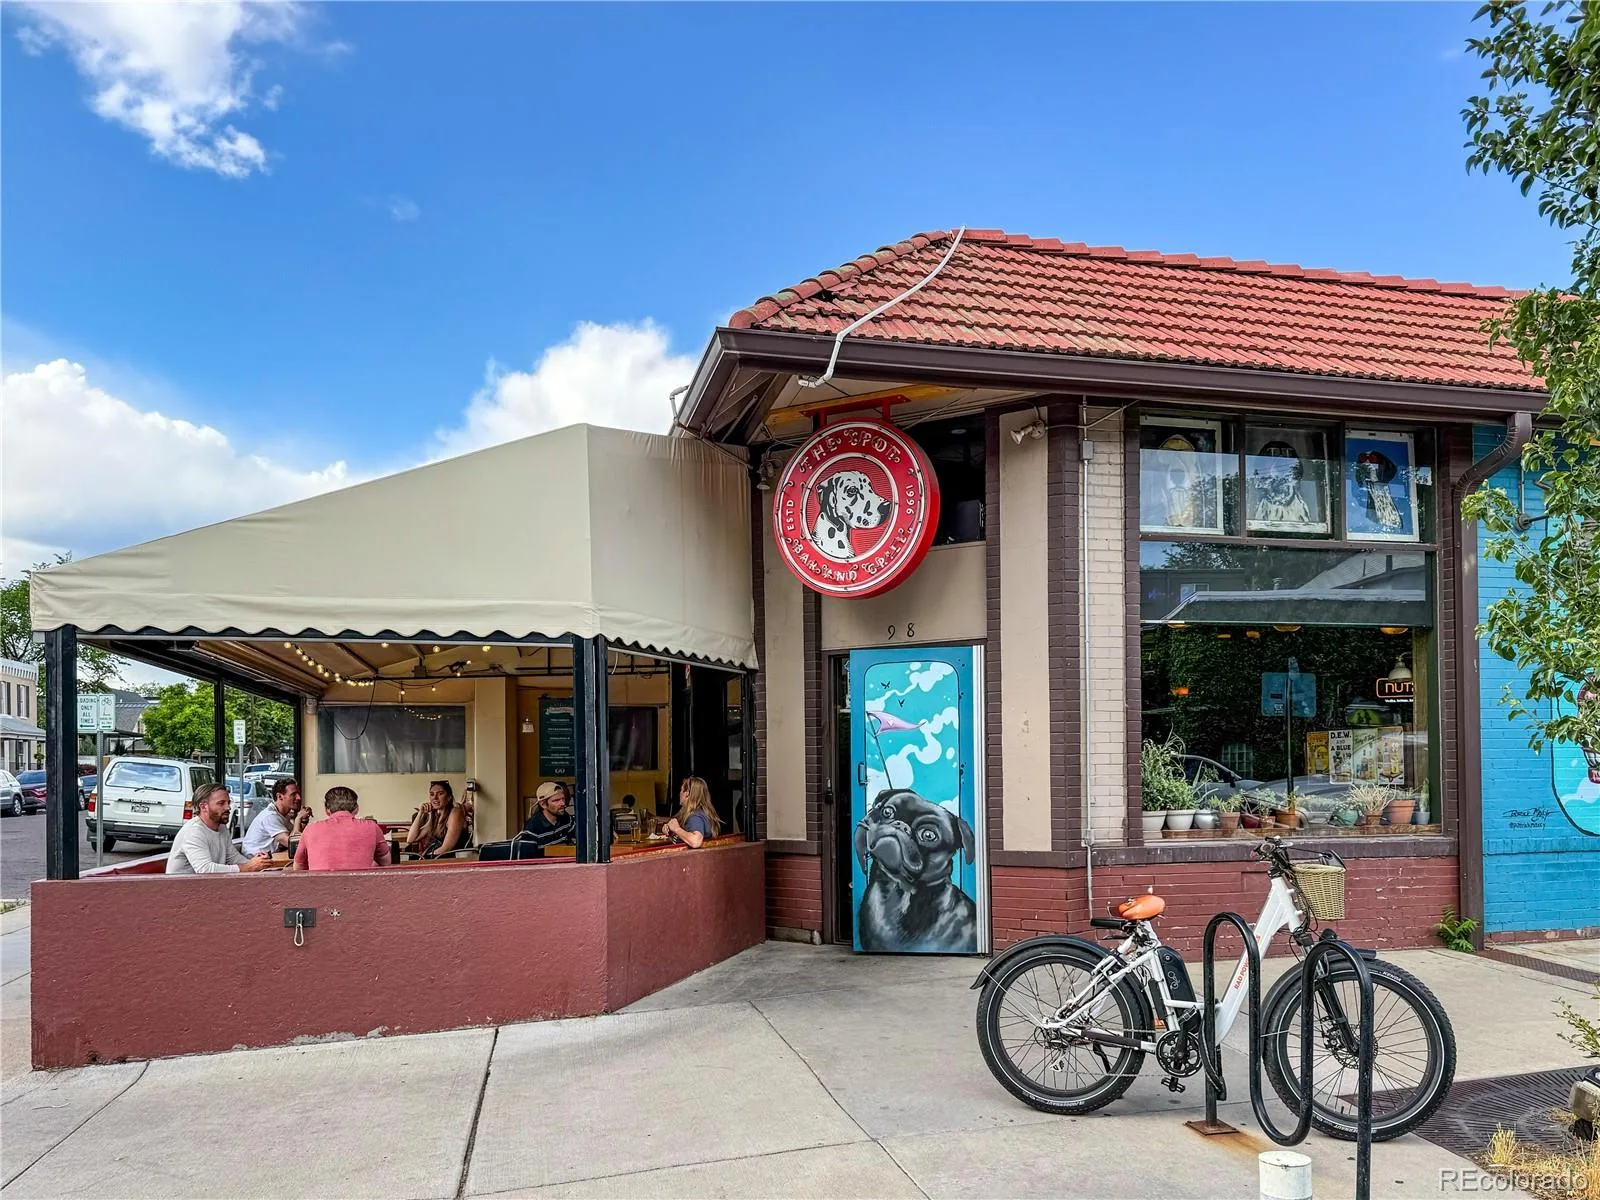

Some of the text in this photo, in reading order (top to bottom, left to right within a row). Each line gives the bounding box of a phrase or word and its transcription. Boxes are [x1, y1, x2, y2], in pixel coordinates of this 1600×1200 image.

[786, 484, 915, 531] ESTD 1996
[1330, 731, 1351, 739] D.E.W.
